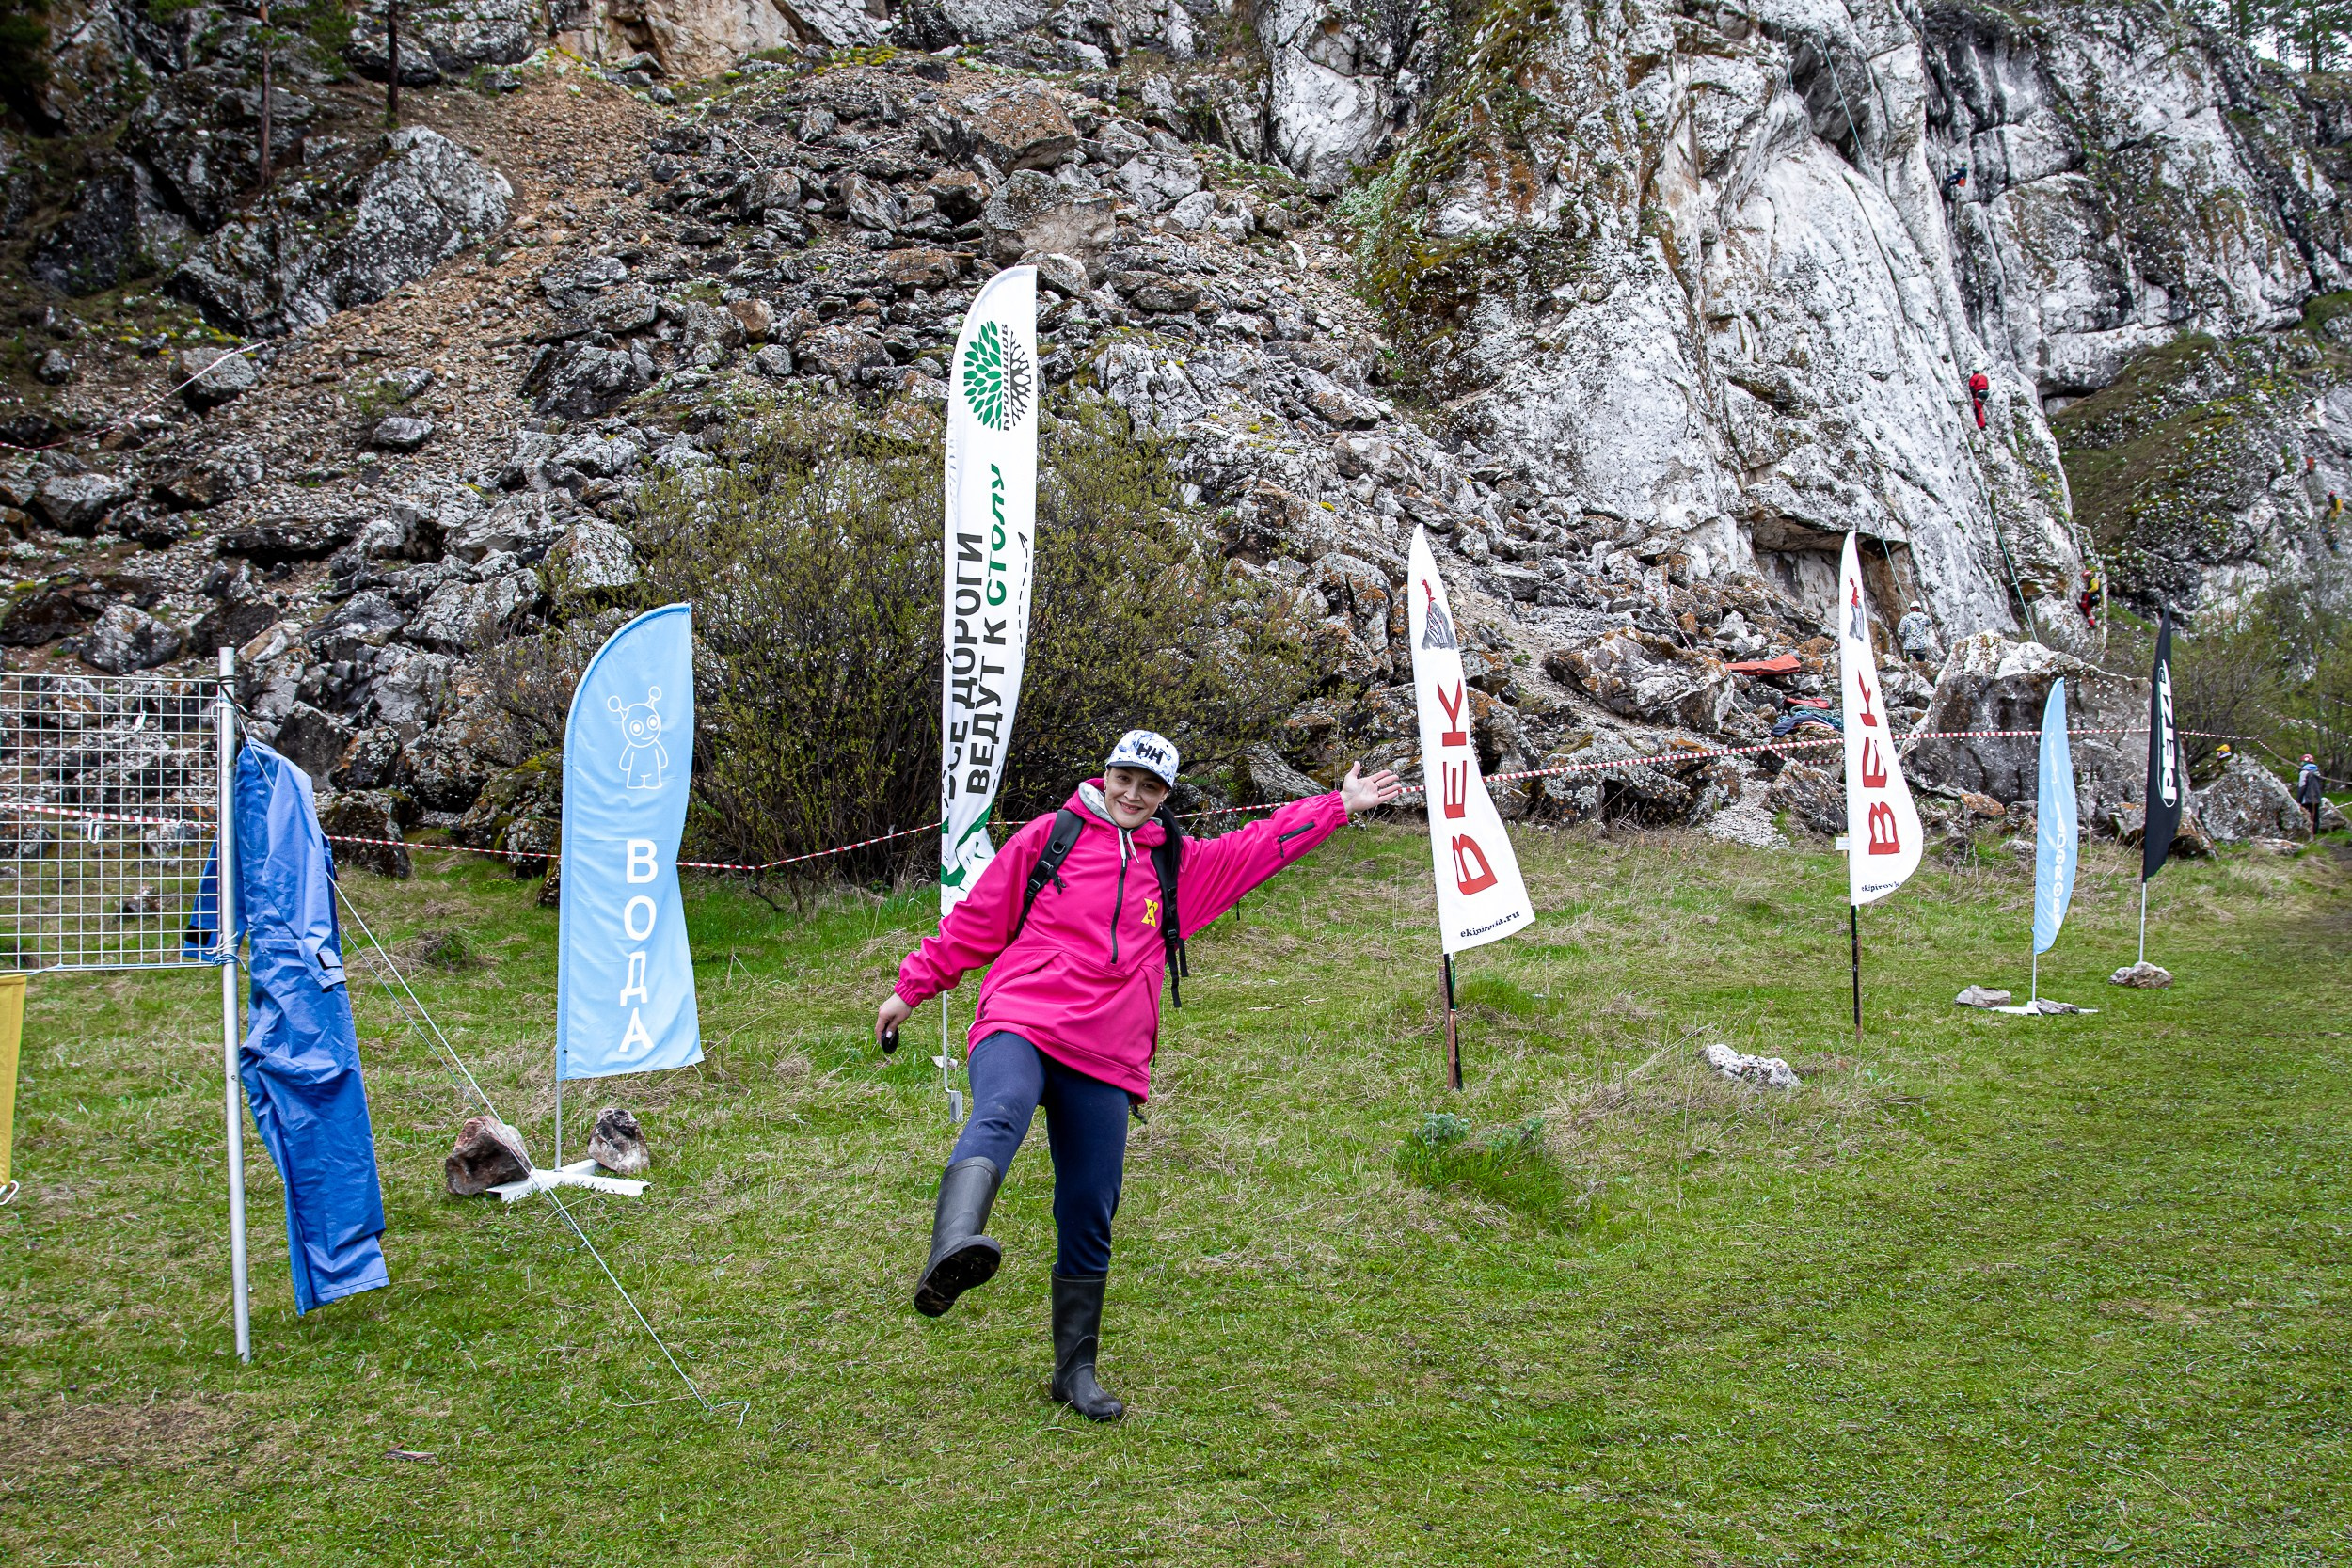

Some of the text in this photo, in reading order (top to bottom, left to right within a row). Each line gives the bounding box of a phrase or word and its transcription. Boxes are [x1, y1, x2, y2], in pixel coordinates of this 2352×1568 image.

[952, 532, 983, 710] ДОРОГИ
[965, 463, 1008, 795] ВЕДУТ К СТОЛУ
[1136, 743, 1164, 765] HH
[2158, 658, 2177, 800] PETZL
[618, 838, 659, 1053] ВОДА
